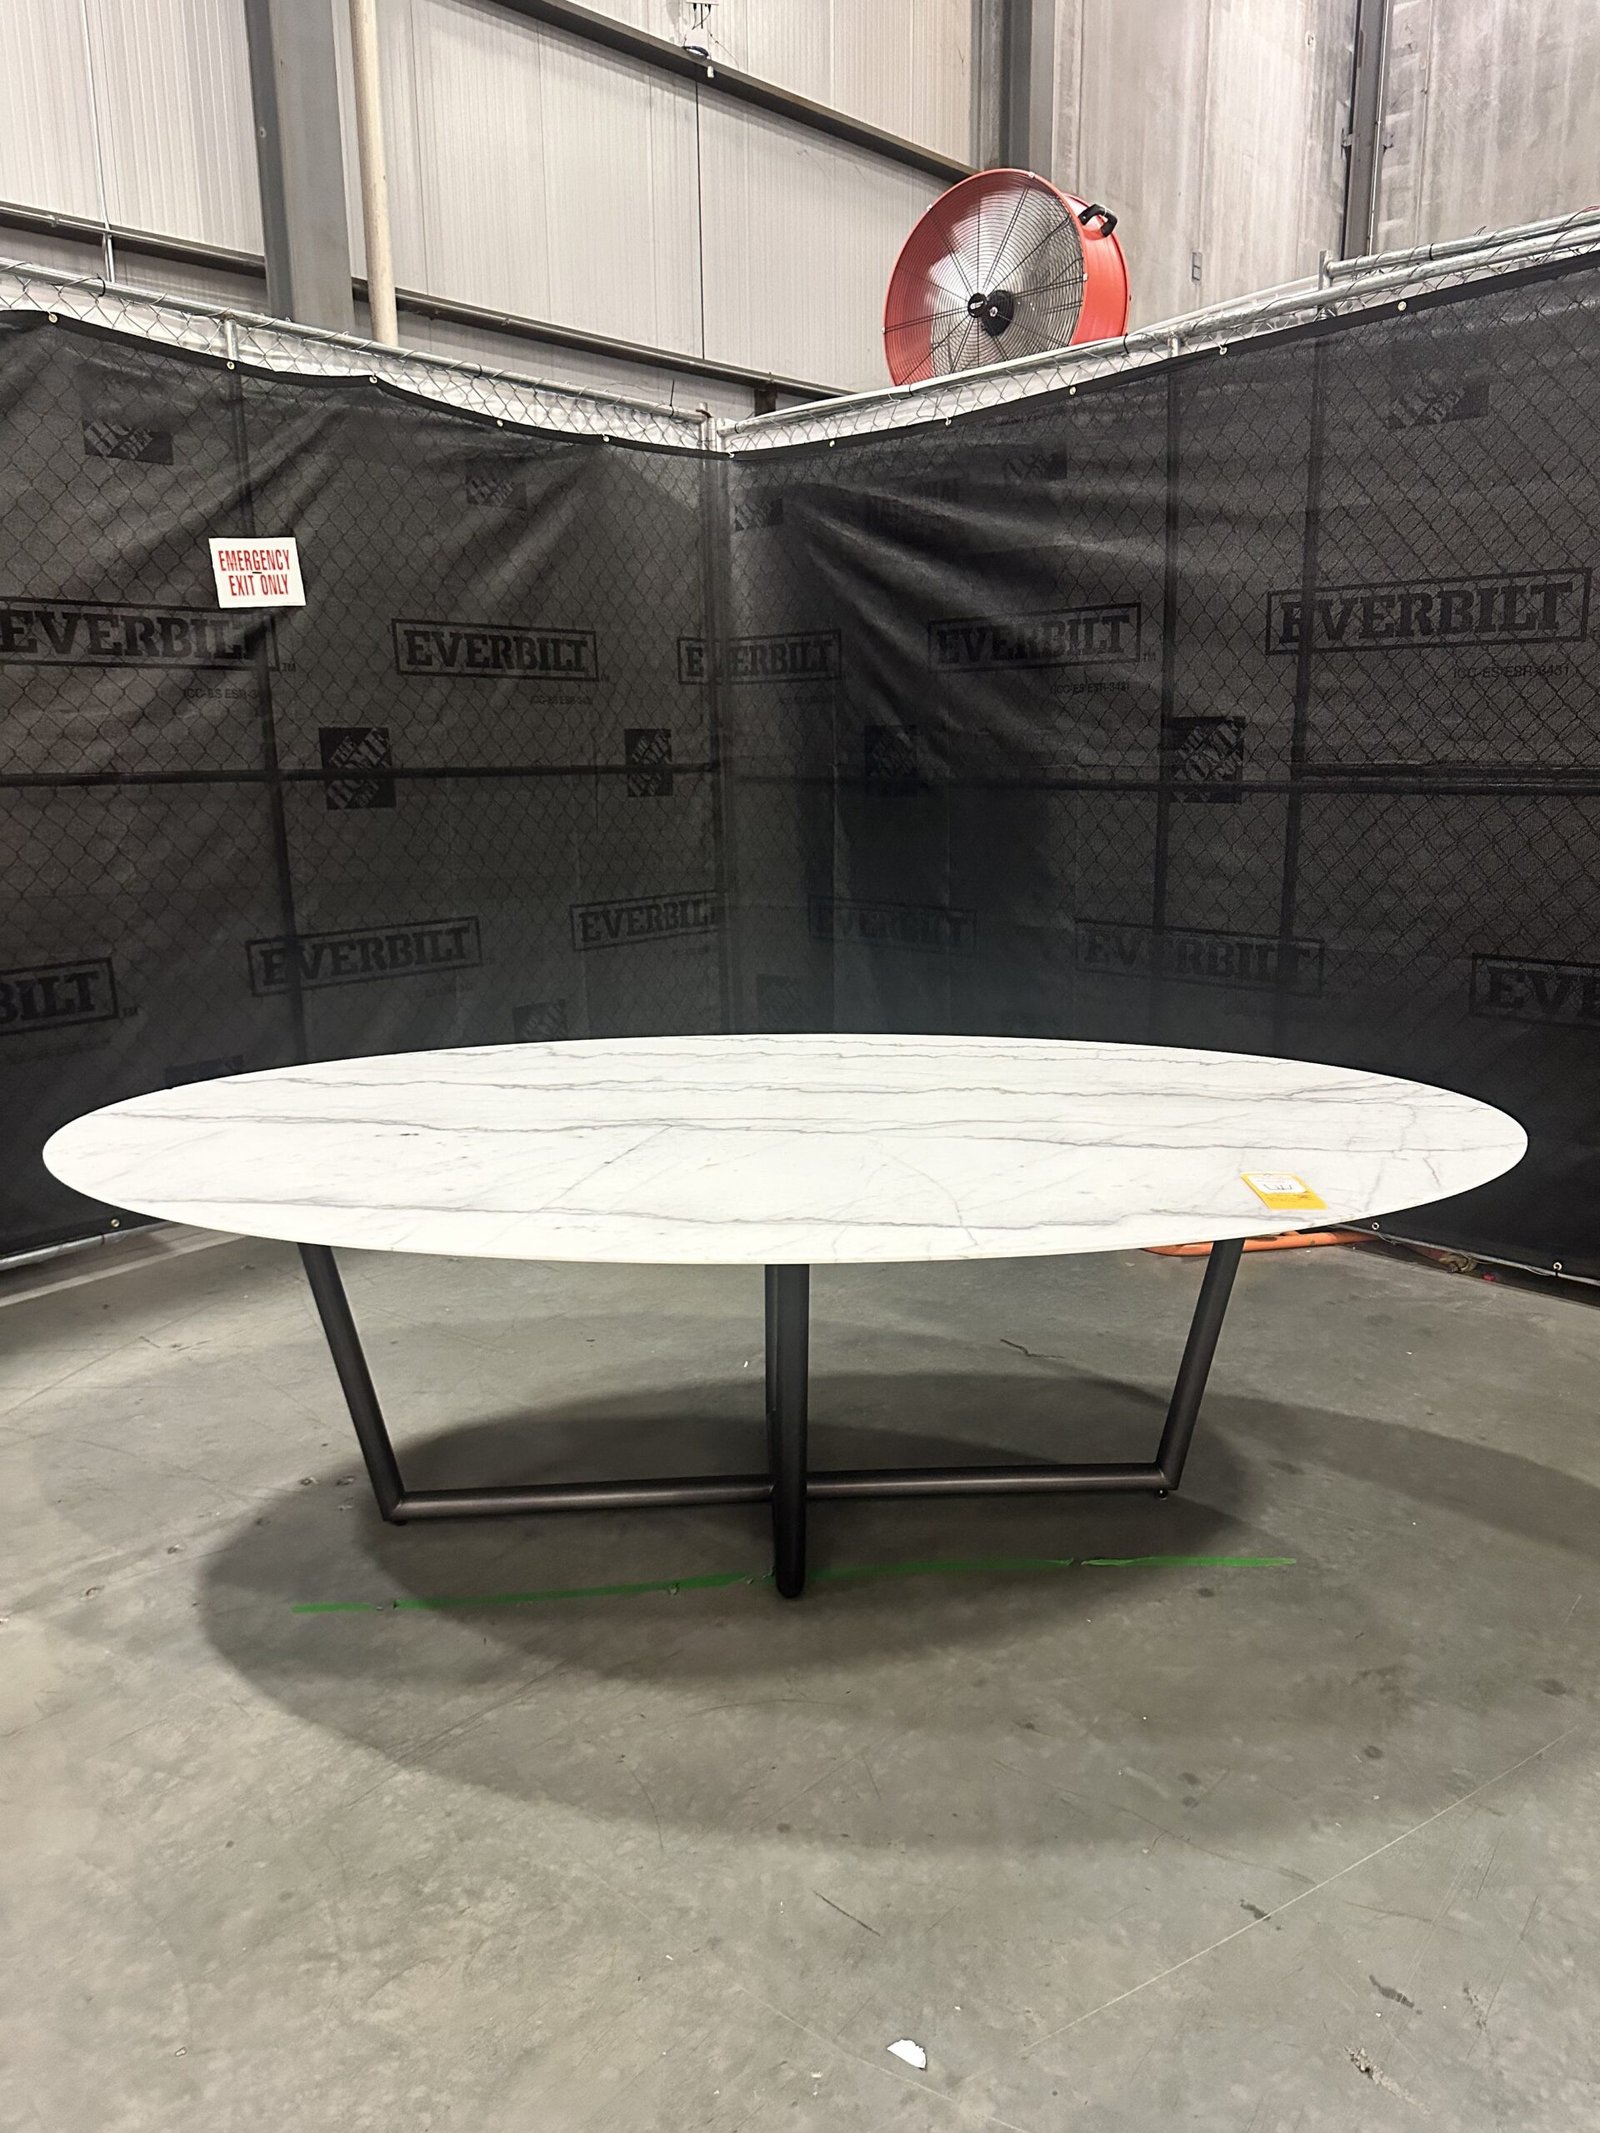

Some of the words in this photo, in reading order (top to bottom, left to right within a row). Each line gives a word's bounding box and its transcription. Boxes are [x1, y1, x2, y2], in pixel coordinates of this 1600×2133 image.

[218, 549, 290, 571] EMERGENCY
[228, 575, 255, 596] EXIT
[260, 574, 288, 595] ONLY
[1279, 582, 1573, 644] EVERBILT
[404, 629, 588, 673] EVERBILT
[685, 639, 834, 678] EERBILT
[259, 926, 470, 985] EVERBILT
[1084, 930, 1311, 984] EVRBIL
